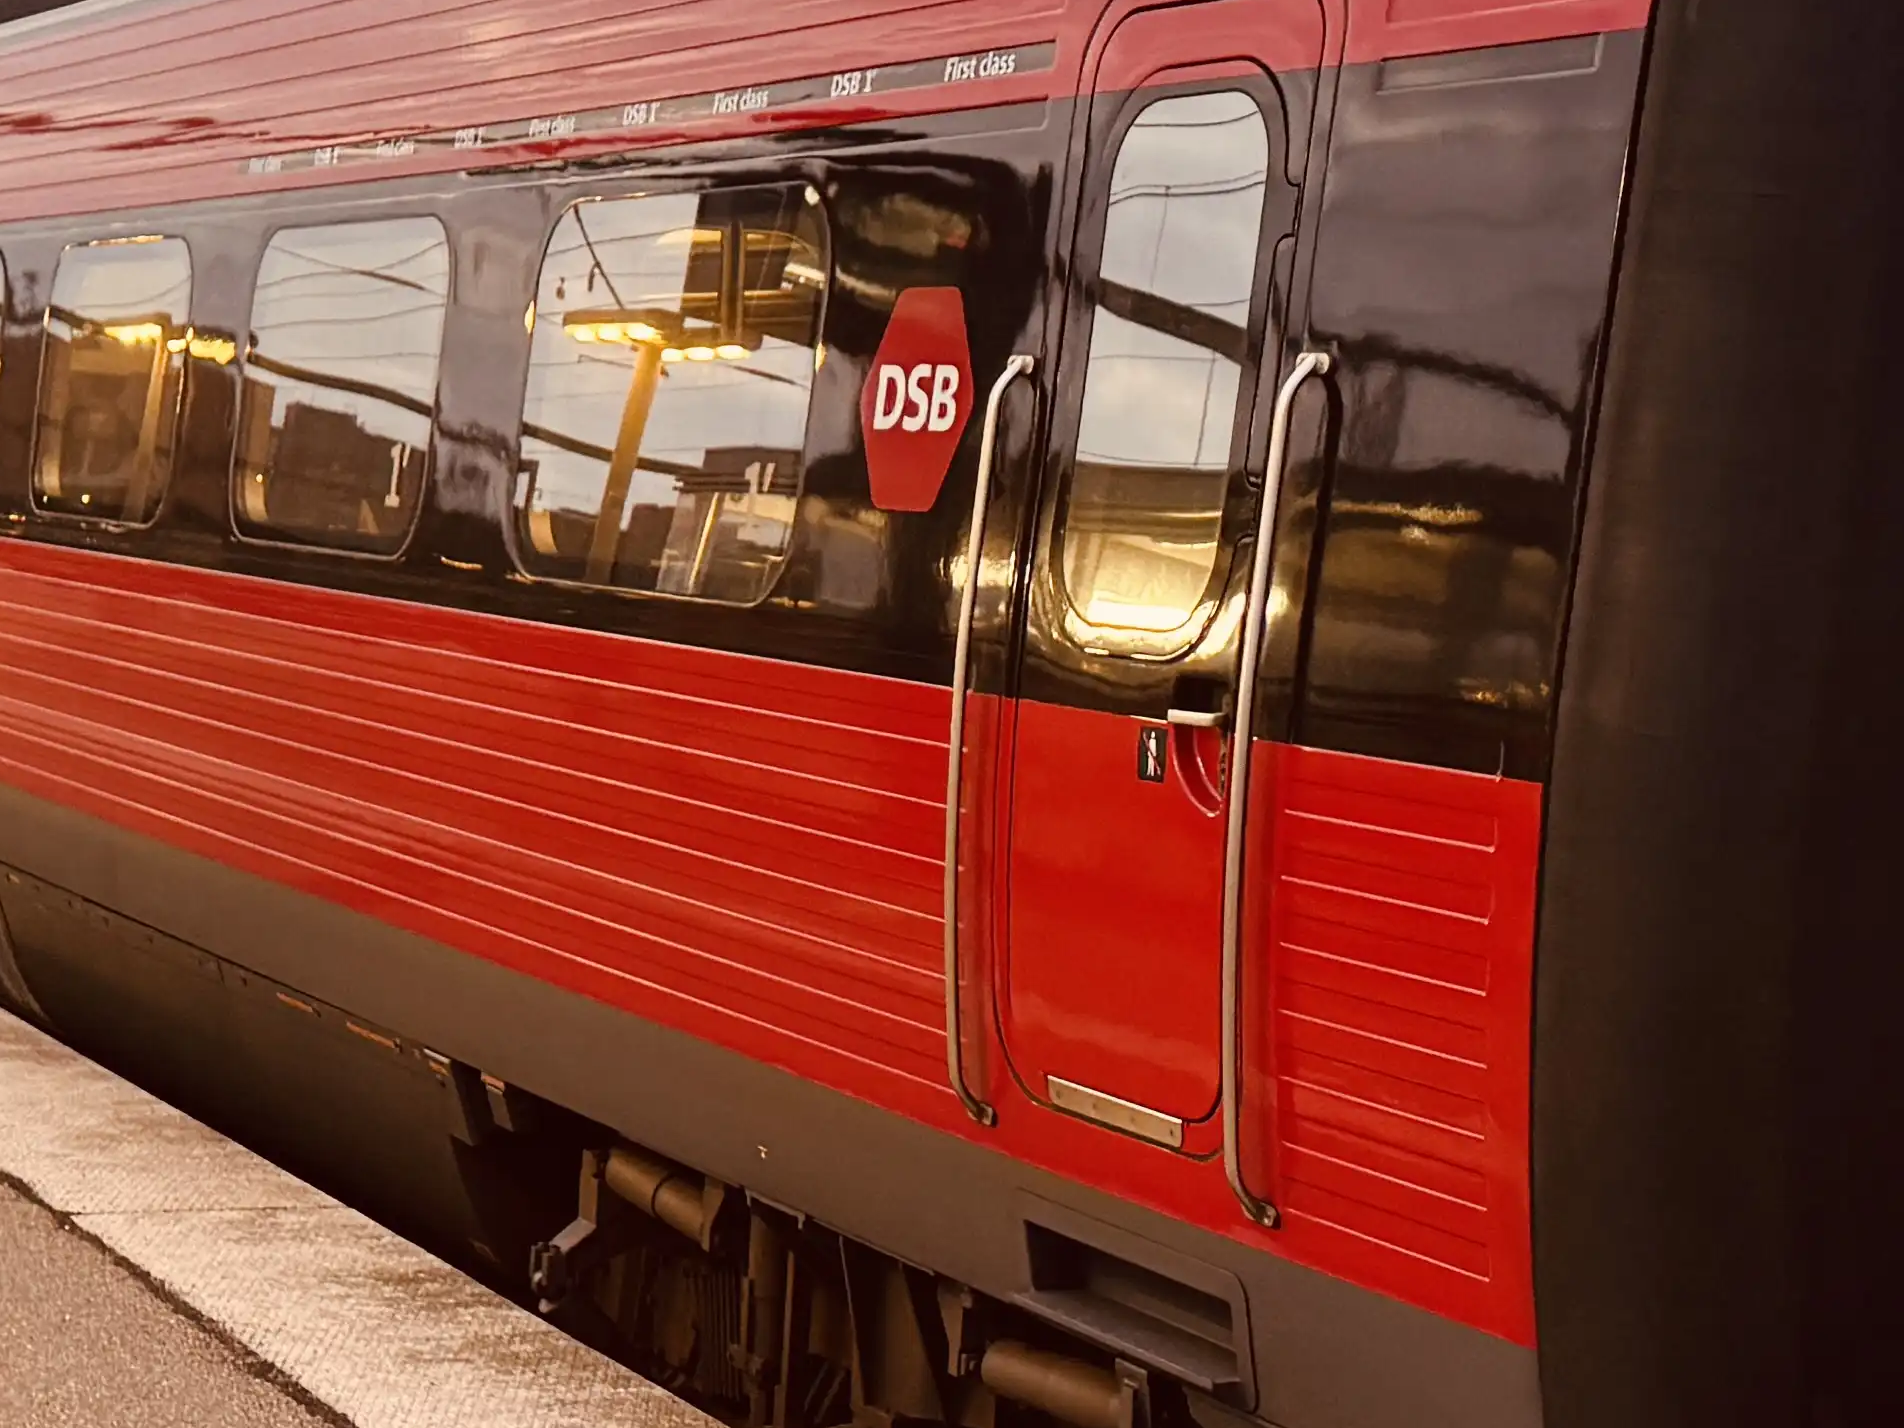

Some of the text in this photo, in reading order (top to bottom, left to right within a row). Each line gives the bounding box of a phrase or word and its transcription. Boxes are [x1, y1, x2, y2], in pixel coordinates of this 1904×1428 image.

[713, 93, 739, 115] First
[739, 88, 769, 113] class
[830, 71, 862, 100] DSB
[943, 57, 977, 82] First
[979, 51, 1016, 77] class
[872, 363, 960, 433] DSB
